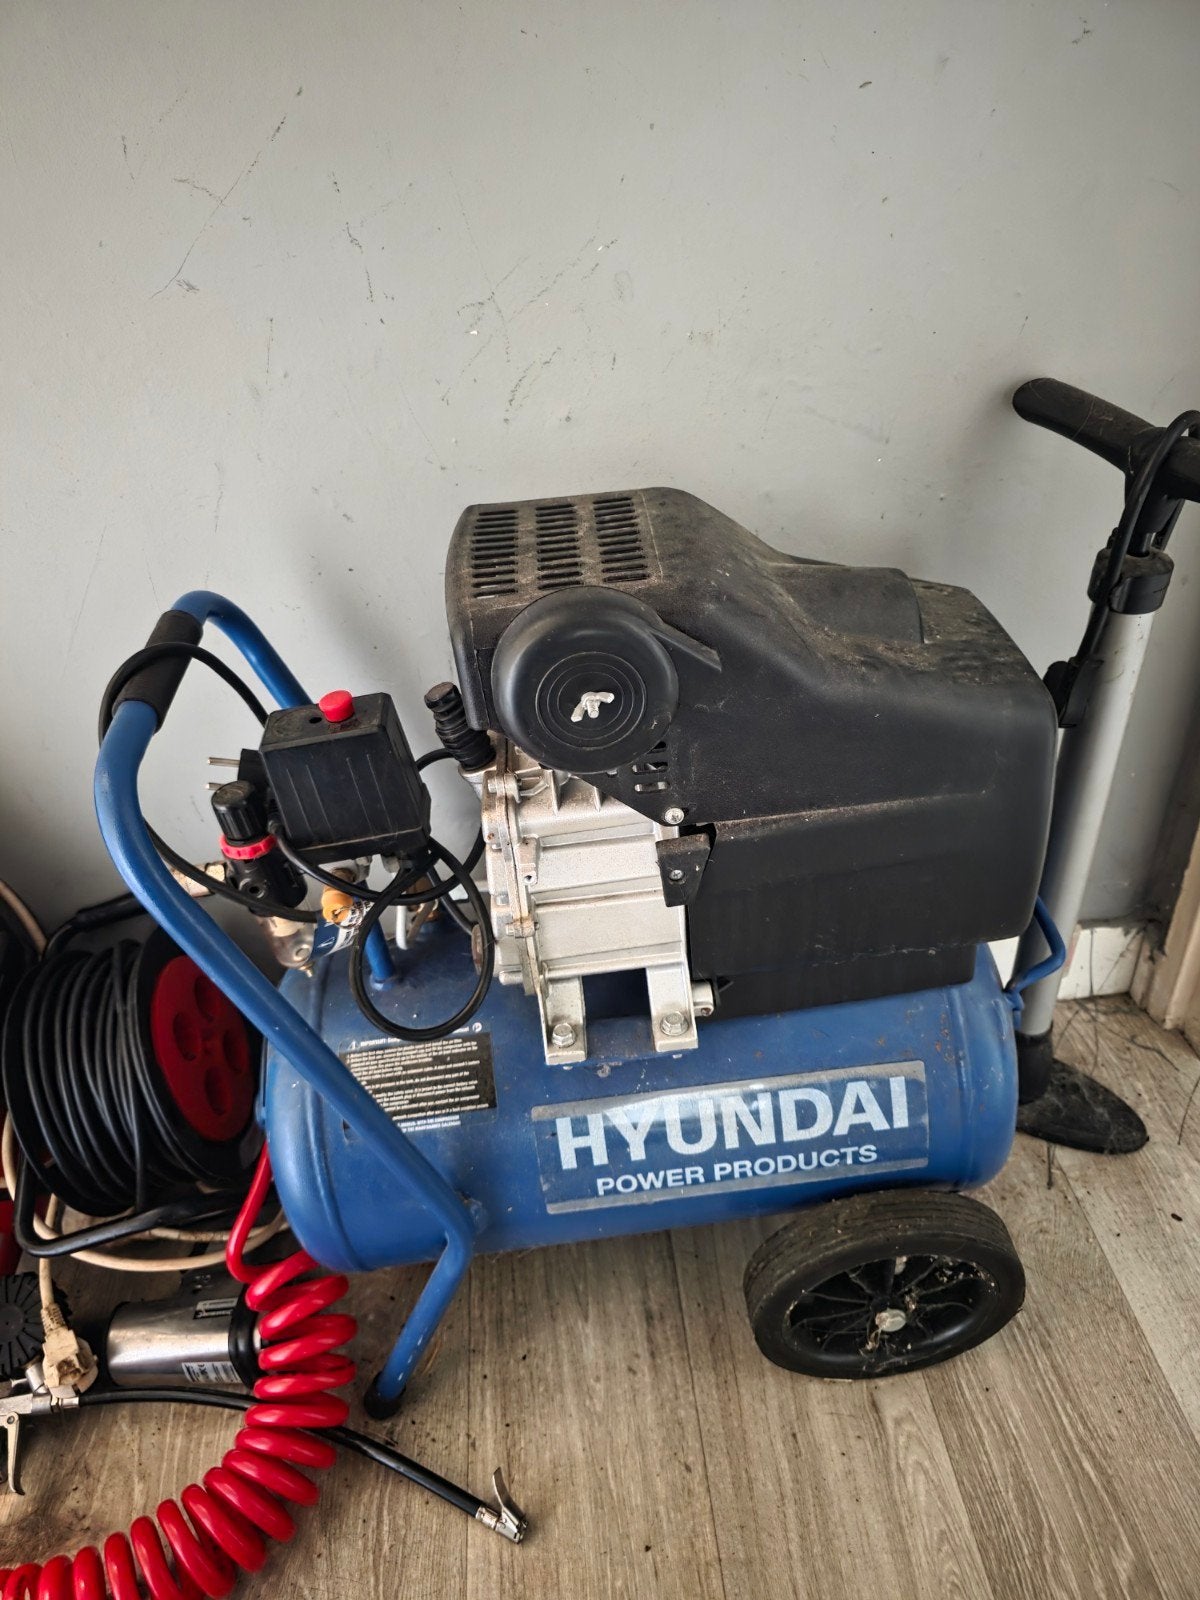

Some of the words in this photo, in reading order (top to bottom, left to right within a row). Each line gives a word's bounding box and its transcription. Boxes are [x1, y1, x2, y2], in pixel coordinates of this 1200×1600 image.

[555, 1076, 909, 1169] HYUNDAI
[596, 1166, 705, 1195] POWER
[713, 1144, 878, 1182] PRODUCTS
